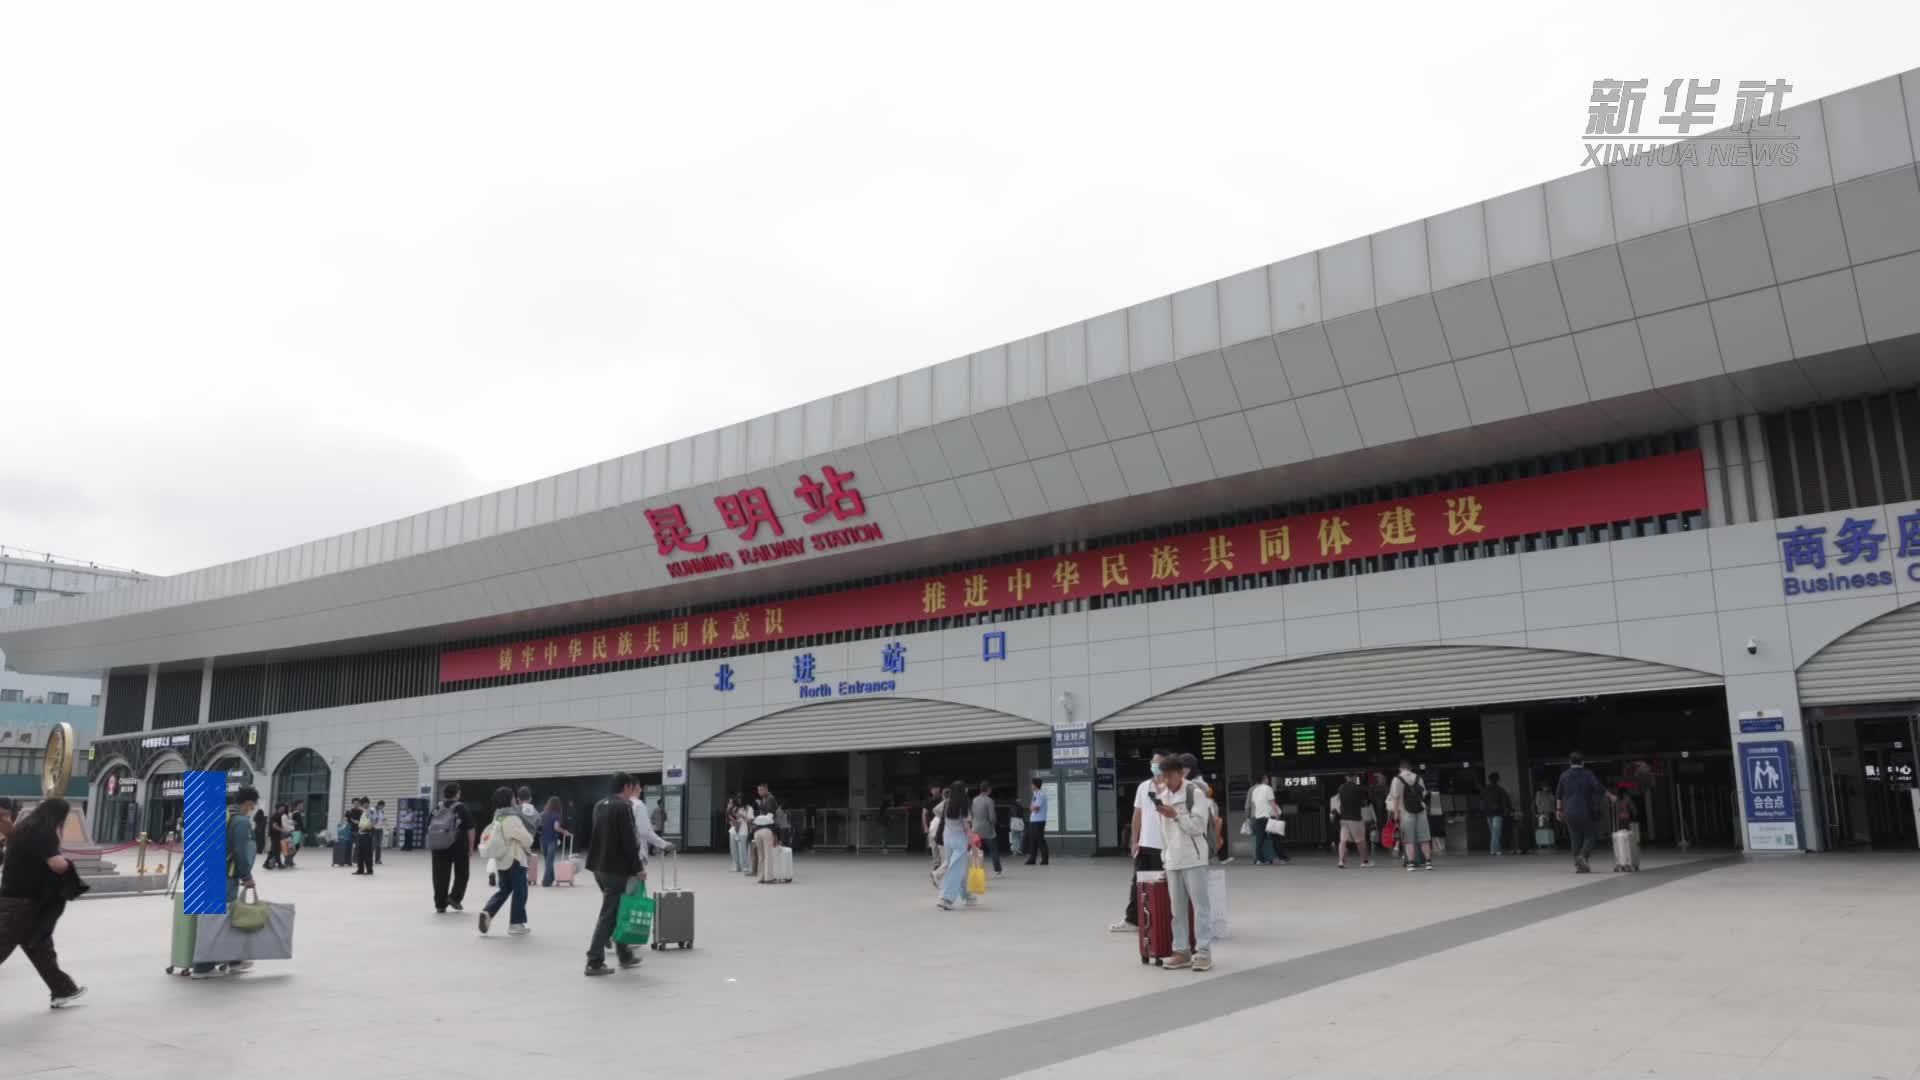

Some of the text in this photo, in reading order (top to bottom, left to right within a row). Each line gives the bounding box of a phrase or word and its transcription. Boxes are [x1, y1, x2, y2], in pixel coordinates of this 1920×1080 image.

[644, 465, 867, 556] 昆明站
[667, 522, 884, 578] KUNMING RAILWAY STATION
[498, 496, 1484, 672] 铸牢中华民族共同体意识 推进中华民族共同体建设
[1784, 571, 1893, 596] Business
[714, 631, 1006, 692] 北进站口
[800, 680, 896, 698] North Entrance
[1754, 795, 1785, 809] 会合点
